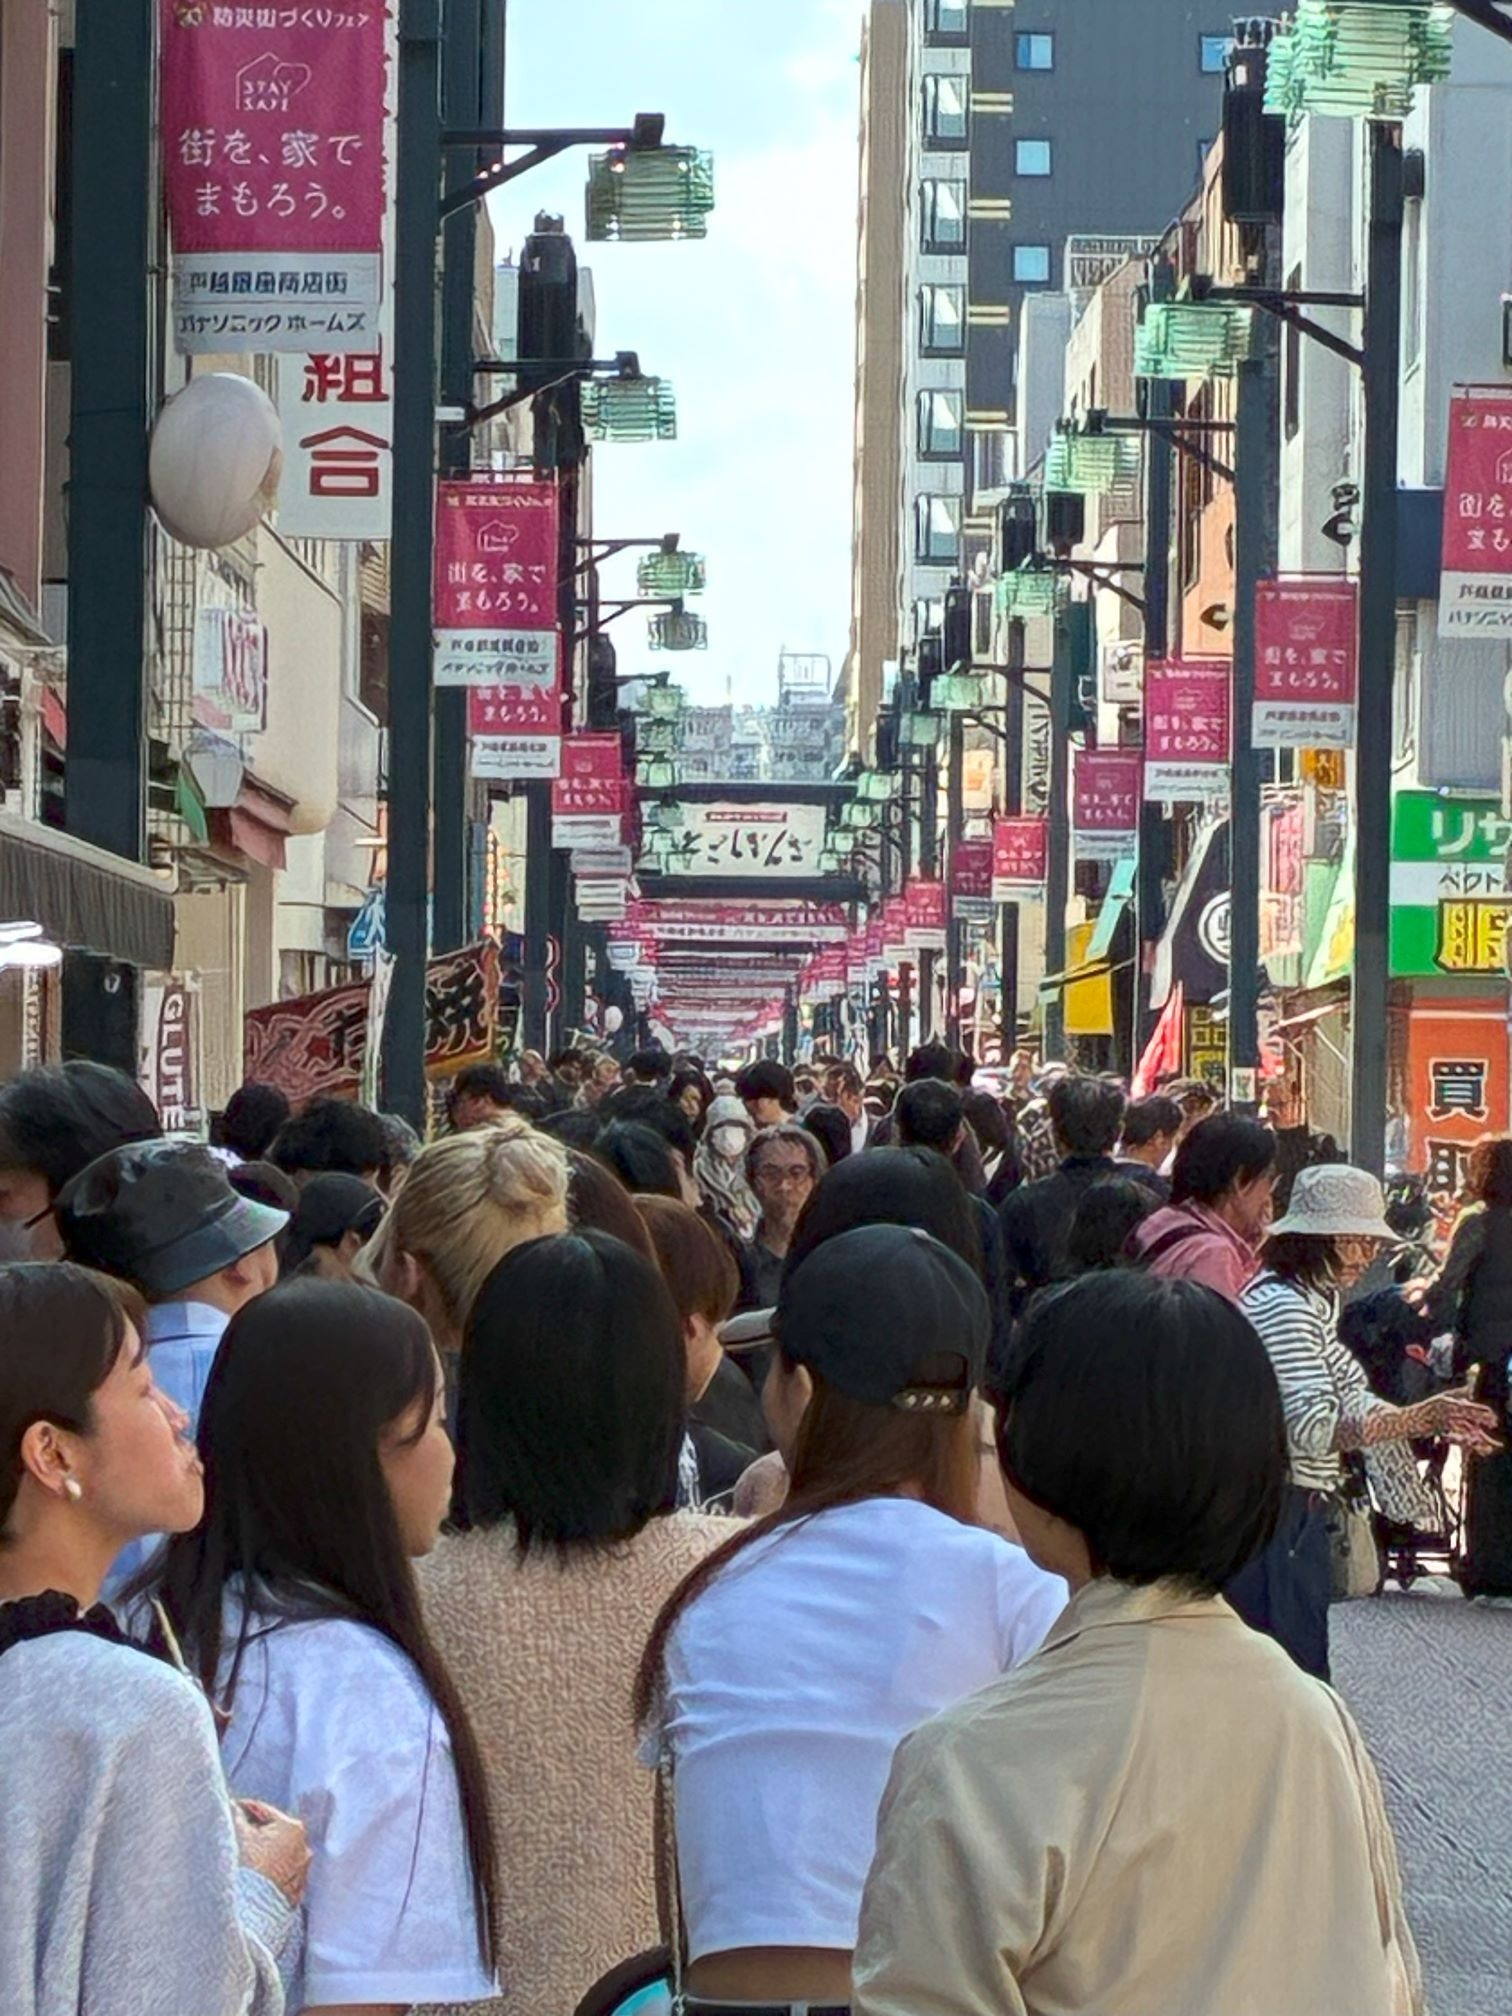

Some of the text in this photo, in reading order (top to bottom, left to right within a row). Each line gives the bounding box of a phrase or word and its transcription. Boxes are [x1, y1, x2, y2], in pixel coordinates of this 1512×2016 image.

[178, 128, 364, 168] 街を、家で
[195, 182, 347, 220] まもろう。
[300, 352, 390, 497] 組合
